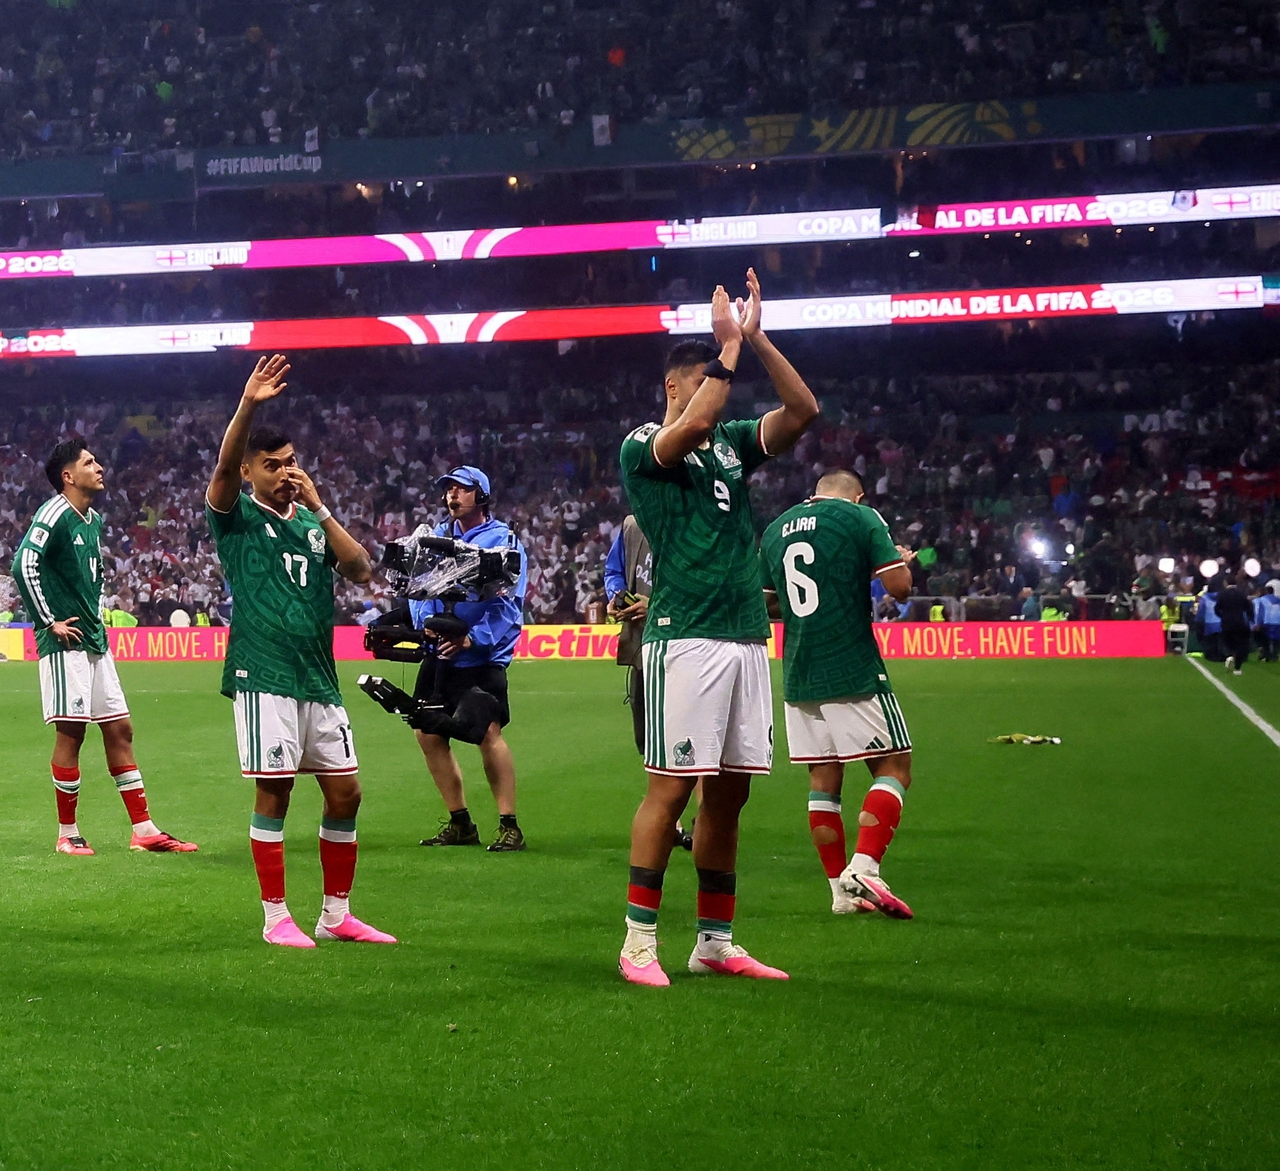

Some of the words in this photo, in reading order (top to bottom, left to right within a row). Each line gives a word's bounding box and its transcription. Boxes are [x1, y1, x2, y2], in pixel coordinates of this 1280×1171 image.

[207, 154, 322, 176] #FIFAWorldCup
[798, 215, 855, 235] COPA
[964, 208, 996, 227] DE
[997, 206, 1030, 226] LA
[1031, 203, 1082, 224] FIFA
[1085, 198, 1170, 221] 2026
[690, 221, 758, 241] ENGLAND
[8, 255, 77, 273] 2026
[187, 247, 248, 265] ENGLAND
[802, 302, 861, 322] COPA
[865, 297, 967, 320] MUNDIAL
[969, 295, 1001, 315] DE
[1003, 294, 1034, 313] LA
[1035, 291, 1088, 312] FIFA
[1090, 287, 1175, 309] 2026
[9, 335, 78, 353] 2026
[189, 328, 251, 346] ENGLAND
[714, 479, 731, 512] 9
[283, 552, 308, 587] 17
[782, 541, 820, 618] 6
[115, 632, 141, 658] AY.
[147, 632, 207, 658] MOVE.
[903, 626, 972, 656] MOVE.
[979, 626, 1035, 656] HAVE
[1043, 626, 1097, 655] FUN!
